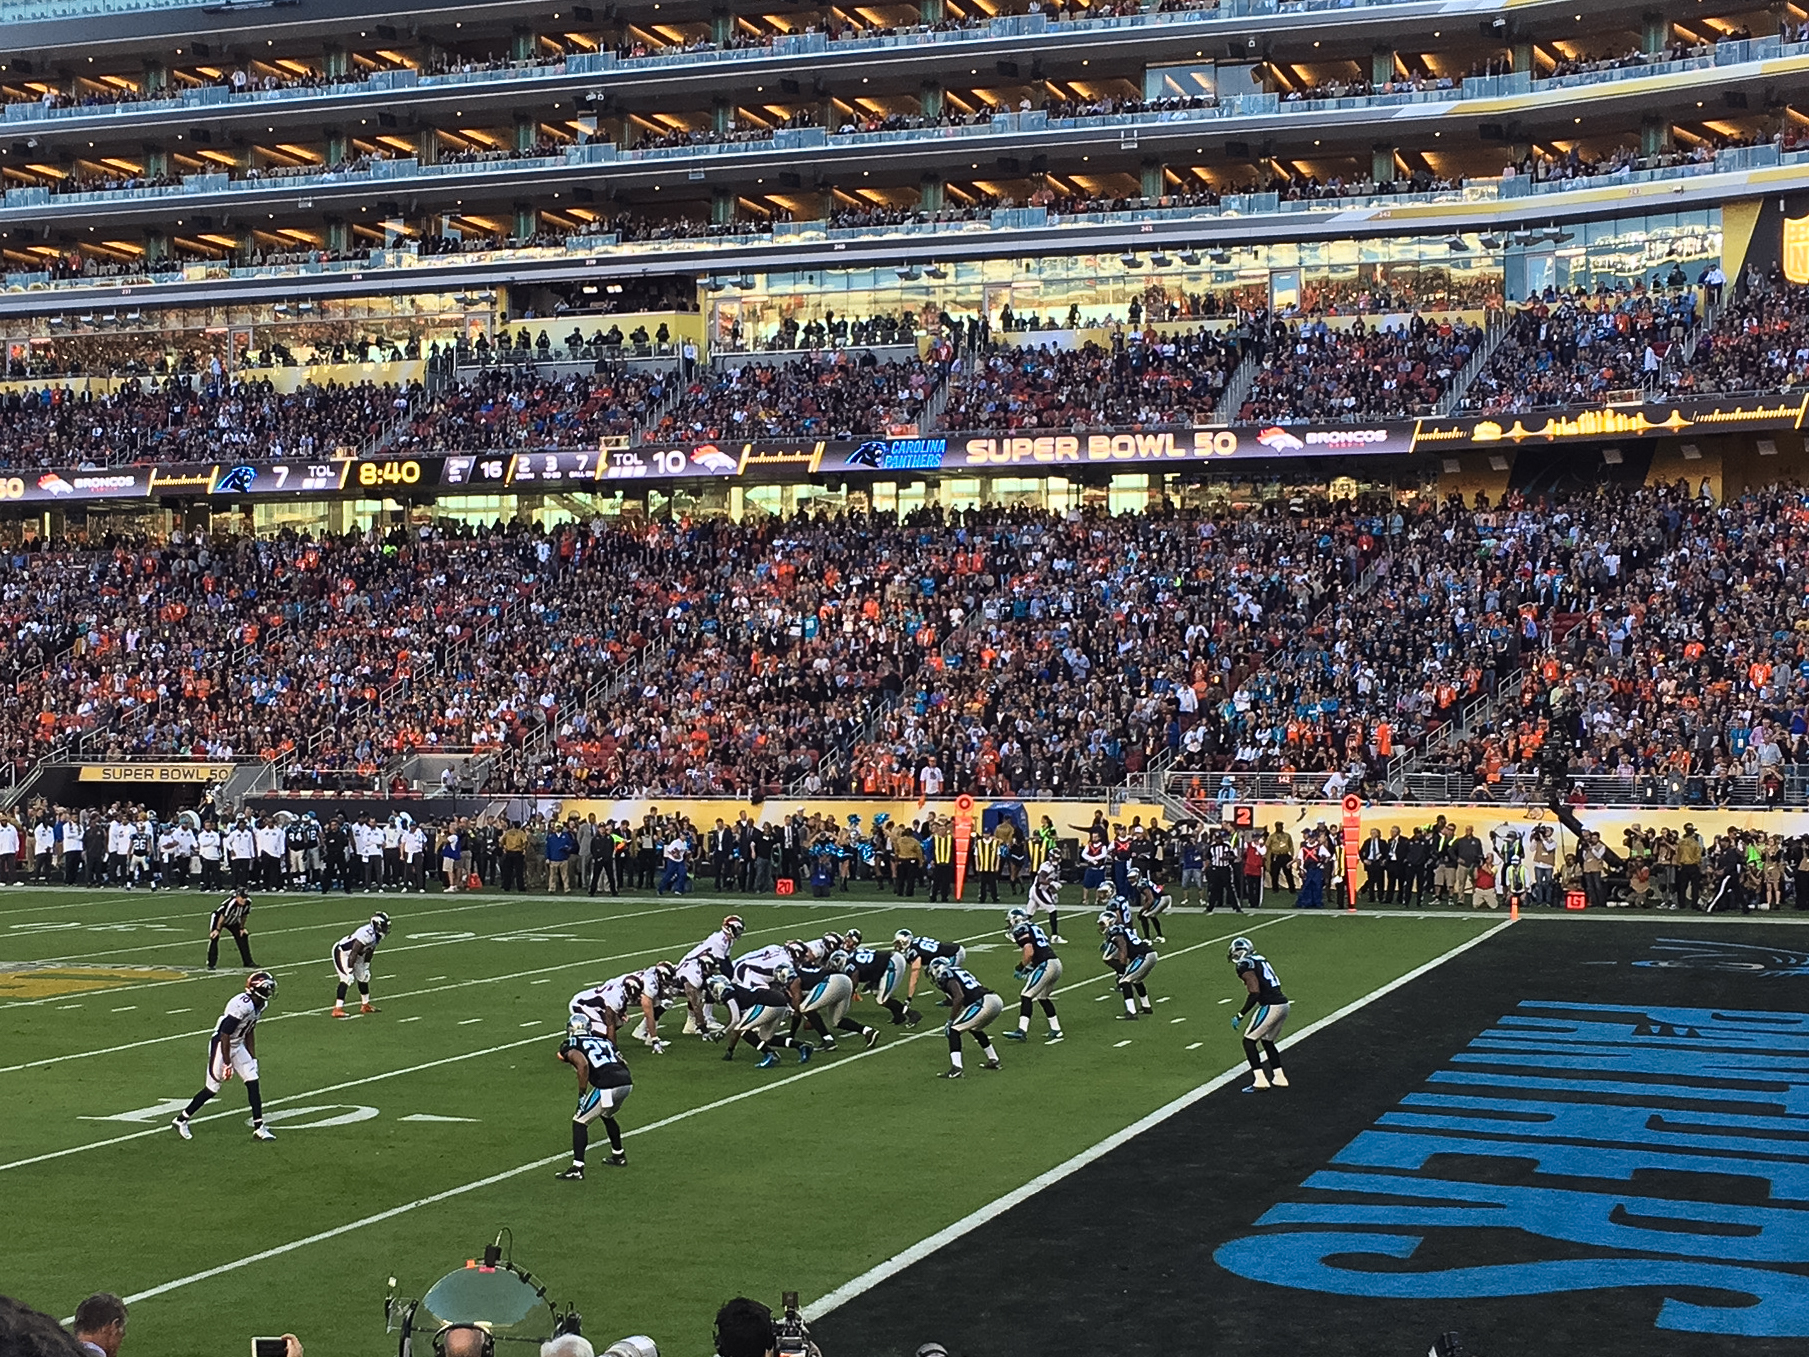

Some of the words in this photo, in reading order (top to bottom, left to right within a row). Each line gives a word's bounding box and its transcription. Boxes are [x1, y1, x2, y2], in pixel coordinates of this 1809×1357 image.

[1305, 429, 1388, 445] BRONCOS
[891, 439, 947, 454] CAROLINA
[966, 436, 1080, 464] SUPER
[1088, 432, 1186, 461] BOWL
[1193, 431, 1238, 457] 50
[518, 457, 531, 473] 2
[545, 455, 558, 472] 3
[575, 455, 589, 471] 7
[613, 453, 644, 466] TOL
[652, 450, 687, 475] 10
[884, 453, 942, 469] PANTHERS
[272, 466, 290, 488] 7
[307, 465, 336, 477] TOL
[359, 461, 421, 485] 8:40
[480, 461, 503, 479] 16
[73, 476, 135, 488] BRONCOS
[102, 768, 154, 780] SUPER
[160, 768, 204, 780] BOWL
[209, 769, 229, 780] 50
[1236, 808, 1251, 825] 2
[133, 839, 146, 850] 26
[582, 1039, 618, 1068] 27
